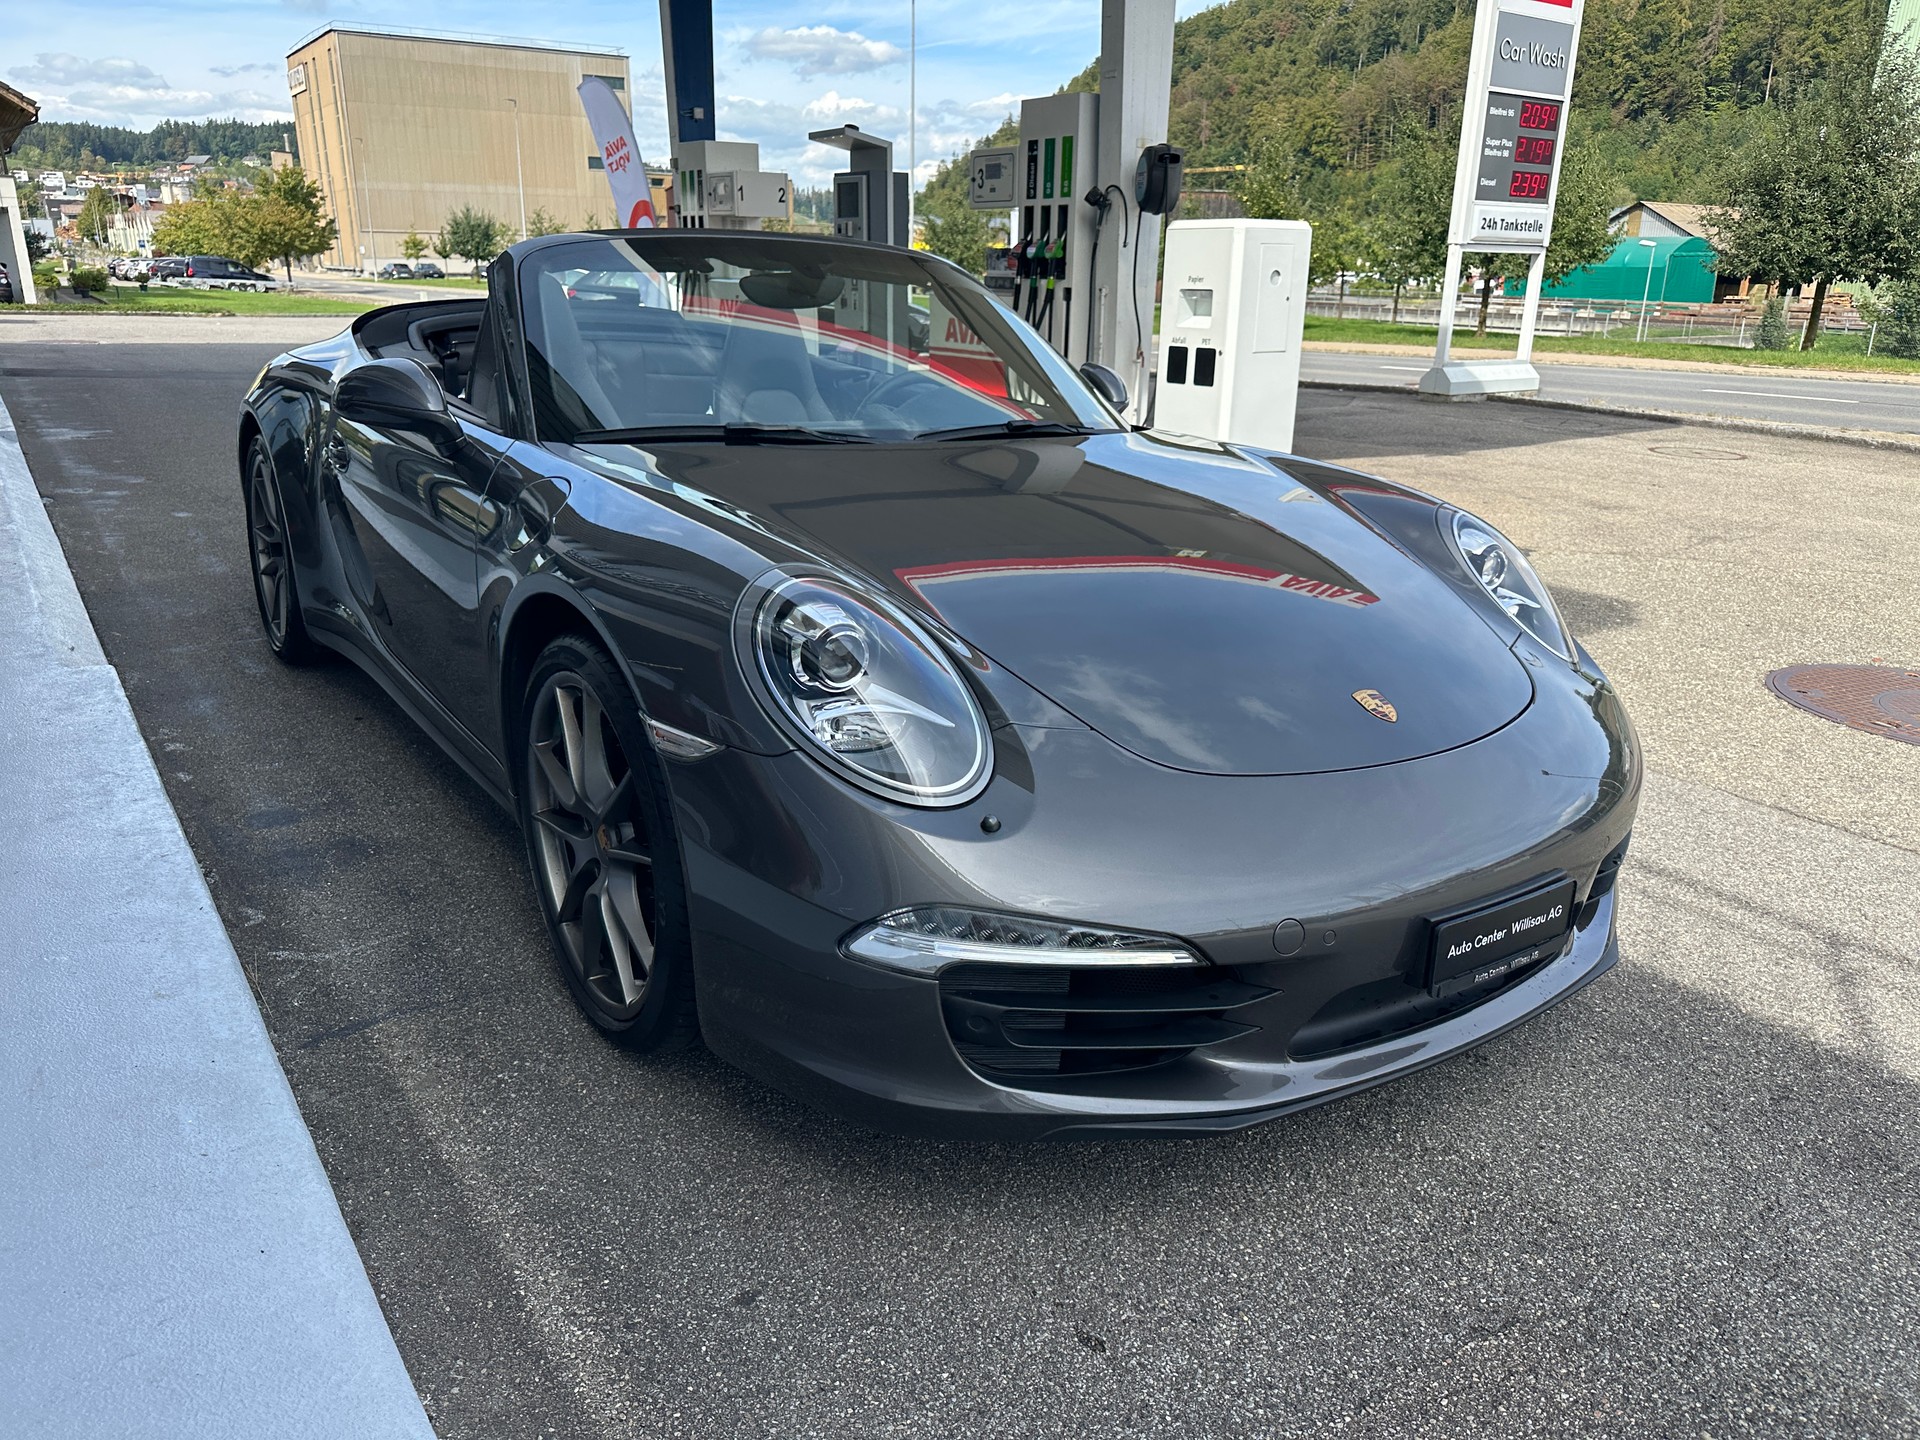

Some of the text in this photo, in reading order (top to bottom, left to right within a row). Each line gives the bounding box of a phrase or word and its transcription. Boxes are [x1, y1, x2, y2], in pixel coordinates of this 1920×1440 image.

[1500, 37, 1565, 69] Car Wash
[1489, 106, 1515, 117] Bleifrei 95
[1485, 137, 1513, 147] Super Plus
[1484, 147, 1510, 157] Bleifrei 98
[977, 168, 984, 189] 3
[1480, 177, 1497, 186] Diesel
[737, 184, 744, 202] 1
[777, 187, 786, 203] 2
[1480, 217, 1543, 232] 24h Tankstelle
[1187, 275, 1204, 284] Papier
[1447, 904, 1563, 959] Auto Center Willisau AG
[1474, 950, 1539, 983] Auto Center Willisau AG
